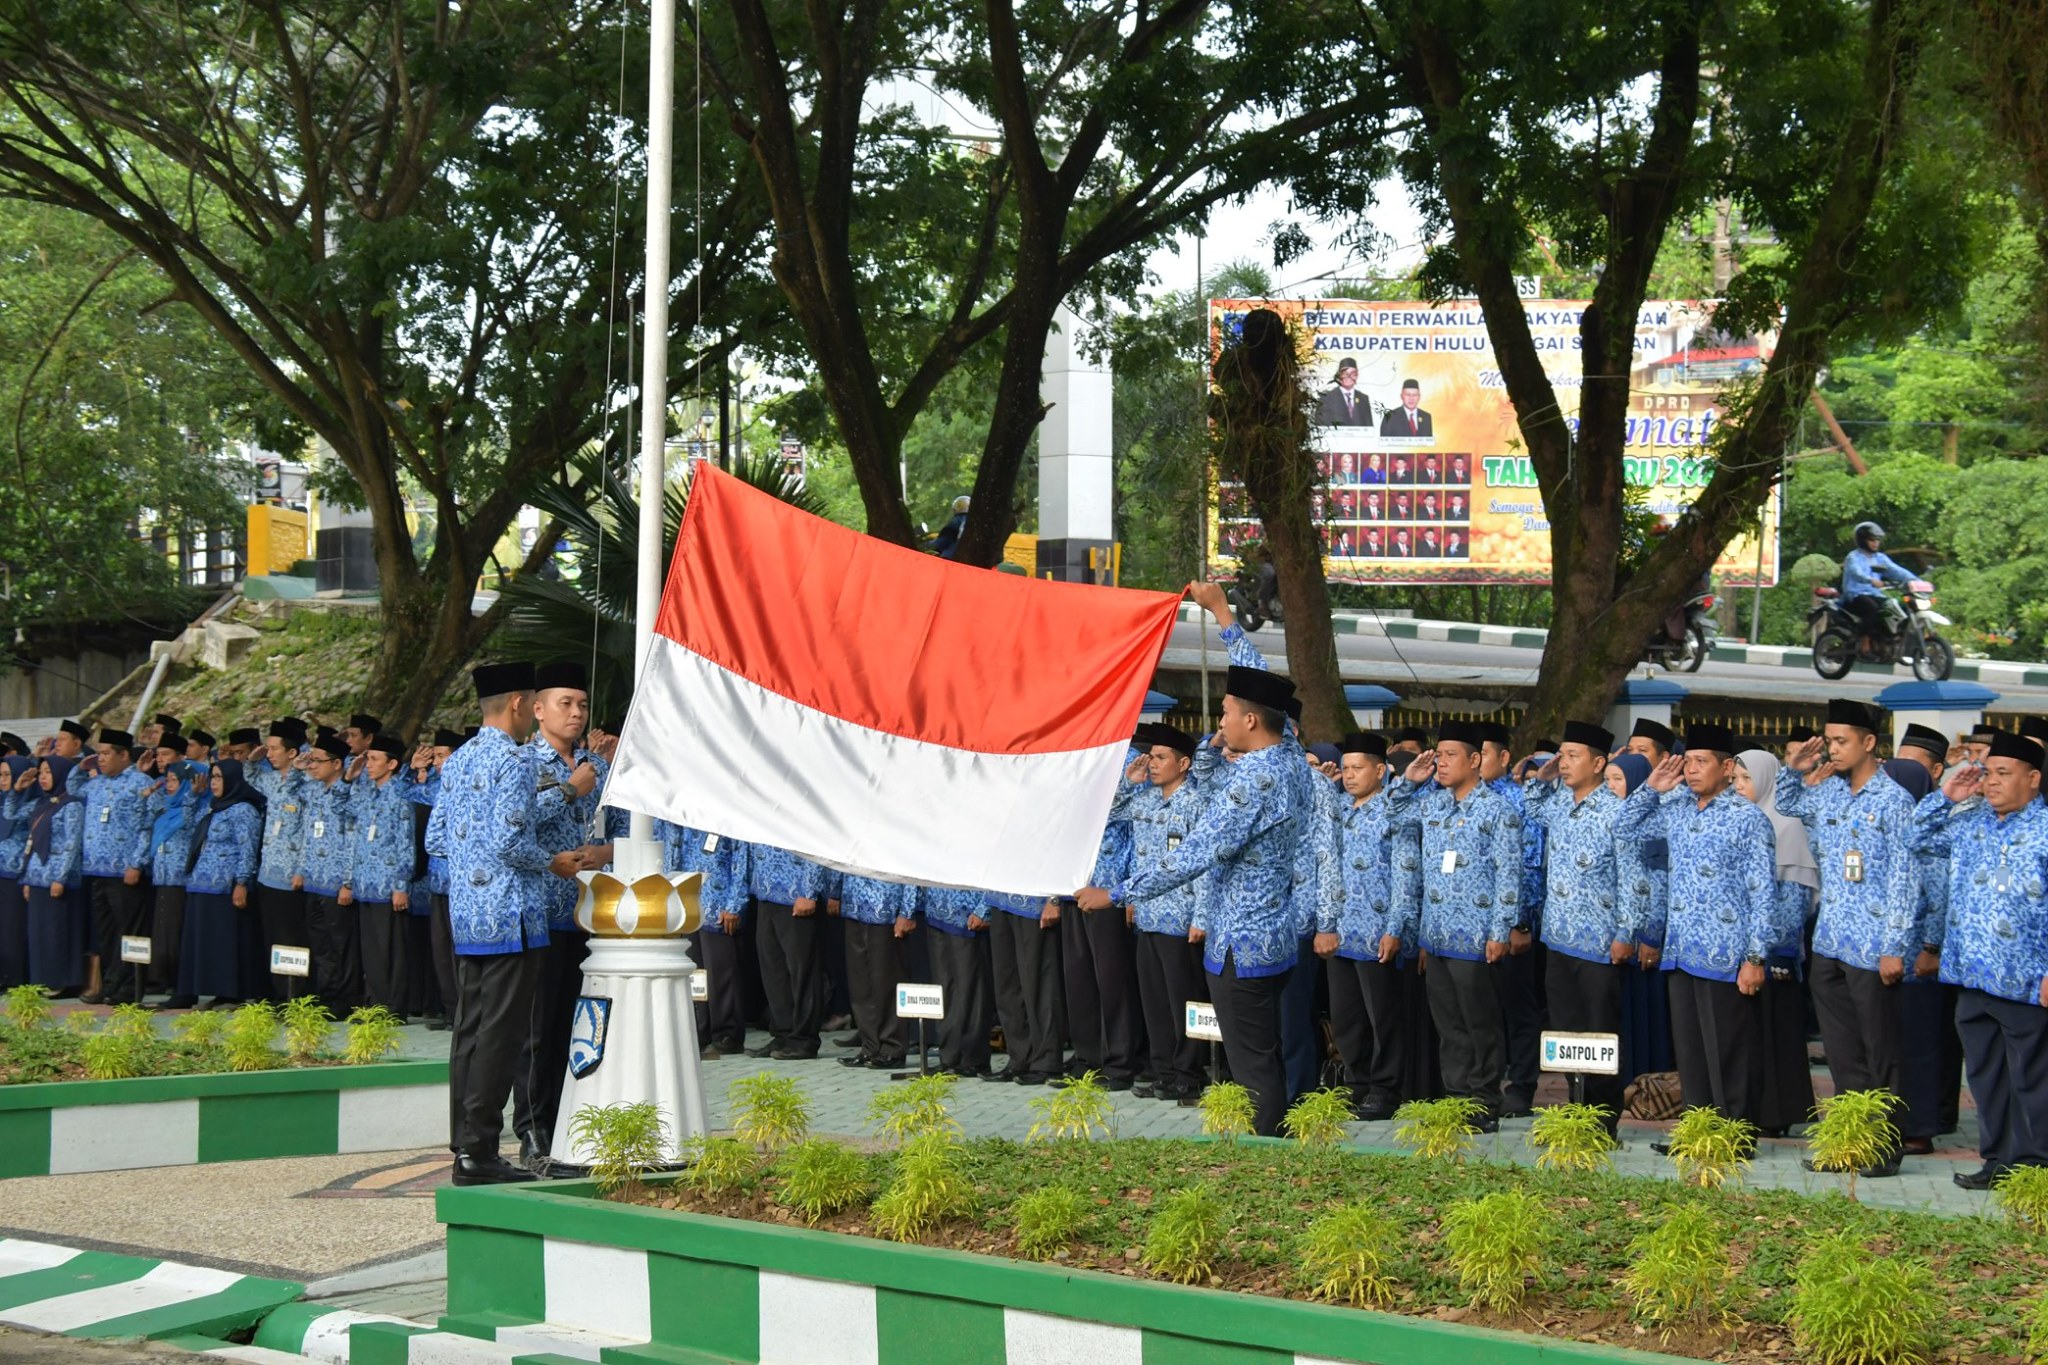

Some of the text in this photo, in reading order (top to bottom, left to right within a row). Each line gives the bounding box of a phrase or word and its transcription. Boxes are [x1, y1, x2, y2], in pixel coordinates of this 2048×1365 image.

[1306, 312, 1583, 326] DEWAN PERWAKILA AKYAT
[1315, 337, 1427, 350] KABUPATEN
[1435, 337, 1485, 350] HULU
[1533, 337, 1564, 350] GAI
[1644, 396, 1690, 409] DPRD
[1484, 458, 1537, 485] TAH
[1623, 459, 1658, 486] RU
[1489, 500, 1534, 517] Semoga
[1198, 1014, 1218, 1027] DISPO
[1559, 1045, 1614, 1062] SATPOL PP
